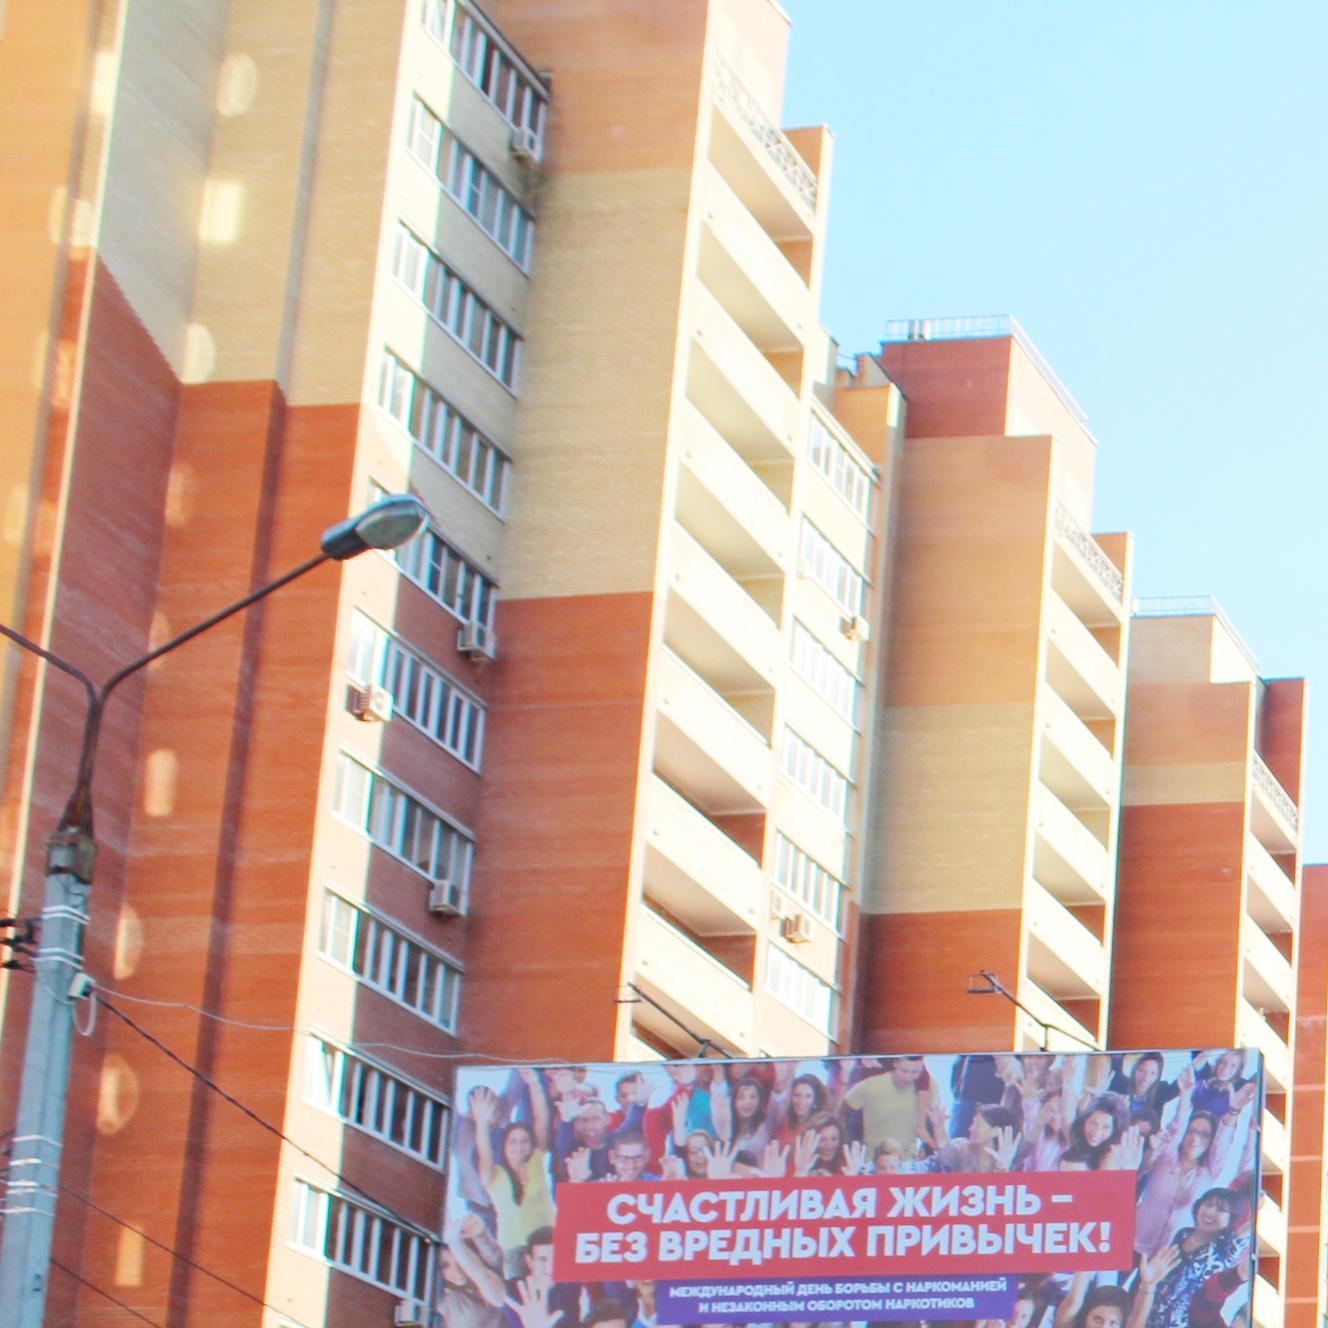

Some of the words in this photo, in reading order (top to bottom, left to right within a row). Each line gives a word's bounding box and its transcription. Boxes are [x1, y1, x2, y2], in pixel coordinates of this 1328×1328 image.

[606, 1187, 877, 1224] СЧАСТЛИВАЯ
[886, 1184, 1042, 1218] ЖИЗНЬ
[575, 1230, 649, 1264] БЕЗ
[657, 1226, 856, 1266] ВРЕДНЫХ
[866, 1221, 1112, 1257] ПРИВЫЧЕК!
[669, 1281, 795, 1299] МЕЖДУНАРОДНЫЙ
[796, 1283, 833, 1297] ДЕНЬ
[834, 1281, 890, 1295] БОРЬБЫ
[892, 1281, 903, 1293] С
[905, 1276, 1007, 1293] НАРКОМАНИЕЙ
[698, 1302, 710, 1313] И
[711, 1300, 805, 1313] НЕЗАКОННЫМ
[806, 1298, 883, 1312] ОБОРОТОМ
[884, 1297, 975, 1310] НАРКОТИКОВ
